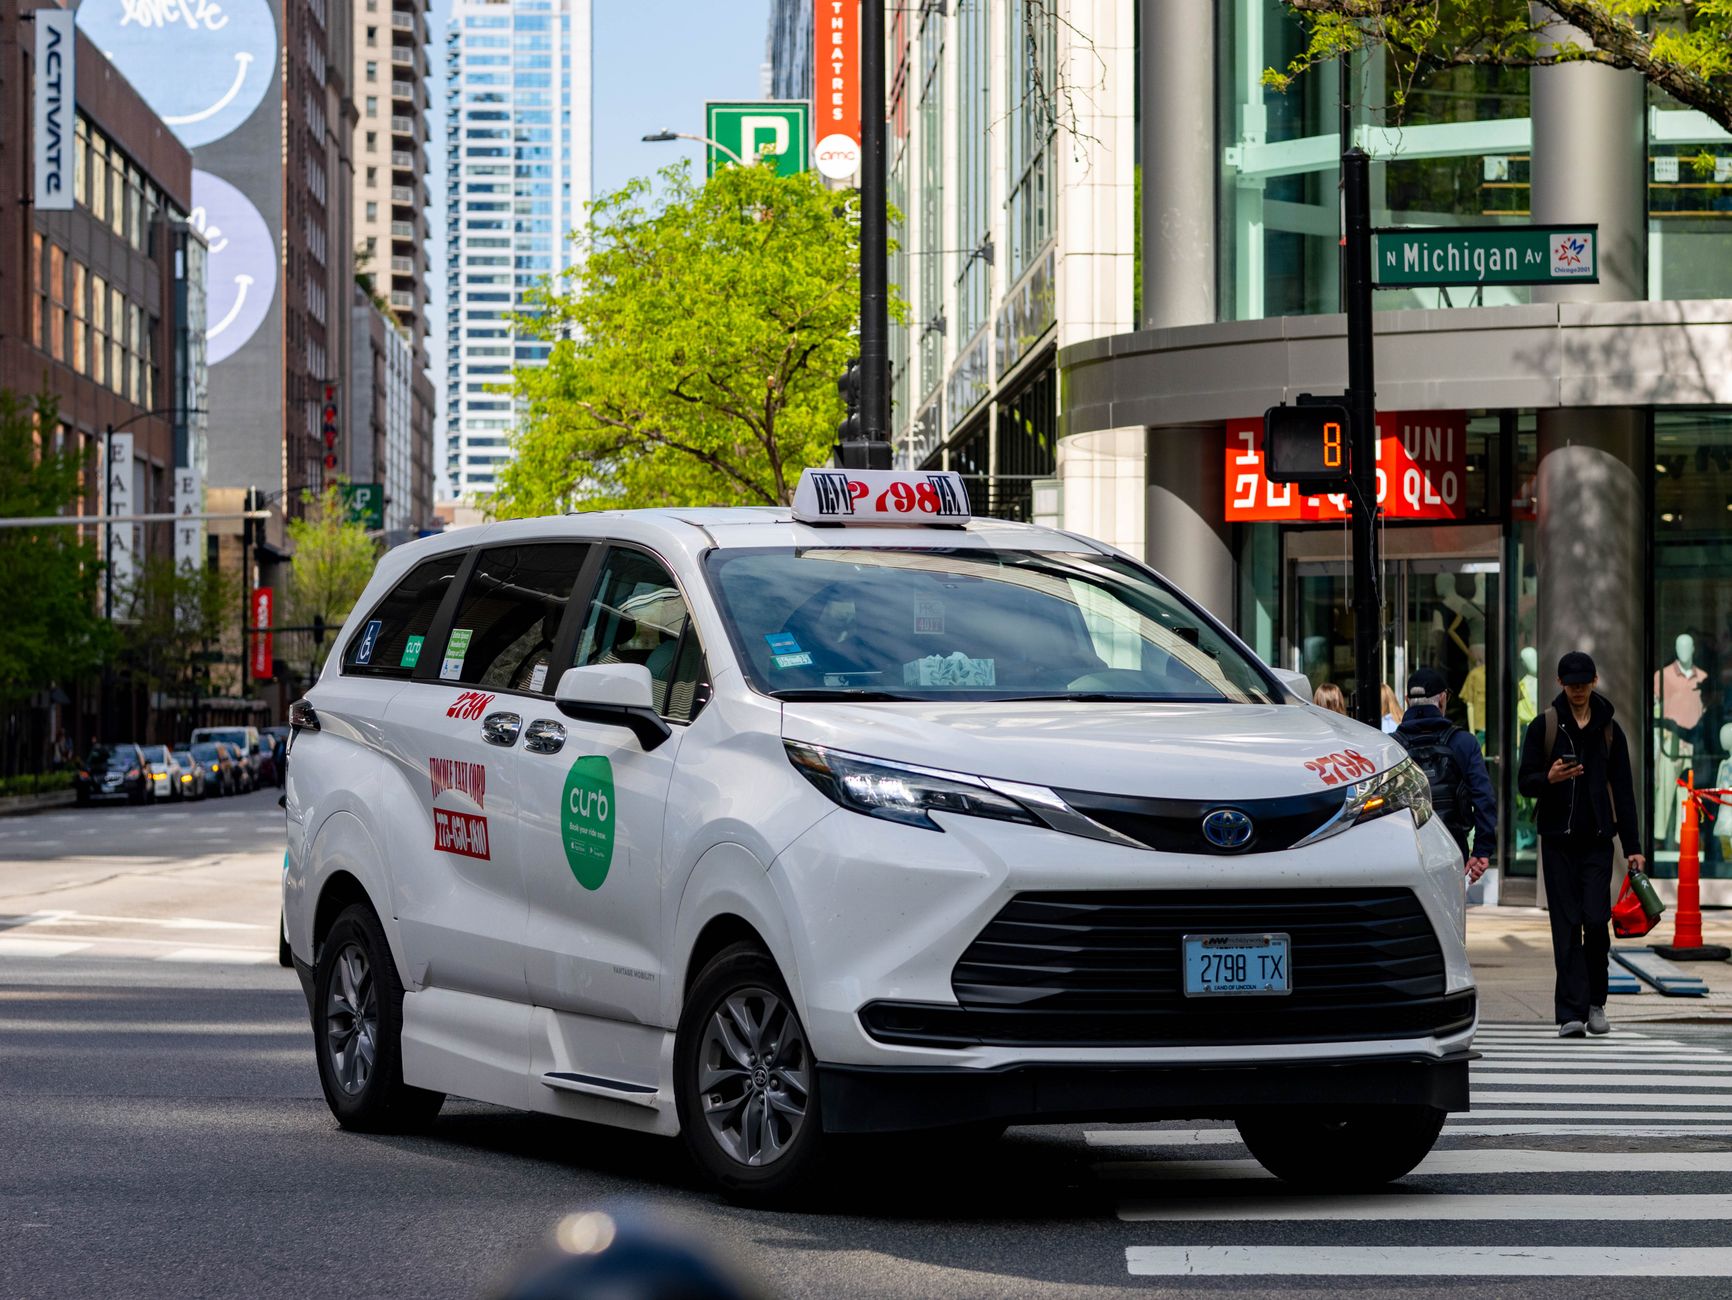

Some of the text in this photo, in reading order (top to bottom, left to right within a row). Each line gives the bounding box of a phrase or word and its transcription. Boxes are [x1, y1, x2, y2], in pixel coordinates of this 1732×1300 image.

[831, 1, 844, 121] THEATRES
[46, 25, 62, 194] ACTIVATE
[741, 116, 790, 167] P
[820, 151, 856, 161] amc
[1386, 242, 1543, 281] N Michigan Av
[1323, 422, 1341, 467] 8
[1404, 425, 1453, 462] UNI
[1403, 468, 1458, 511] QLO
[445, 691, 496, 721] 2798
[1303, 748, 1376, 786] 2798
[569, 787, 609, 822] curb
[1200, 954, 1283, 983] 2798 TX
